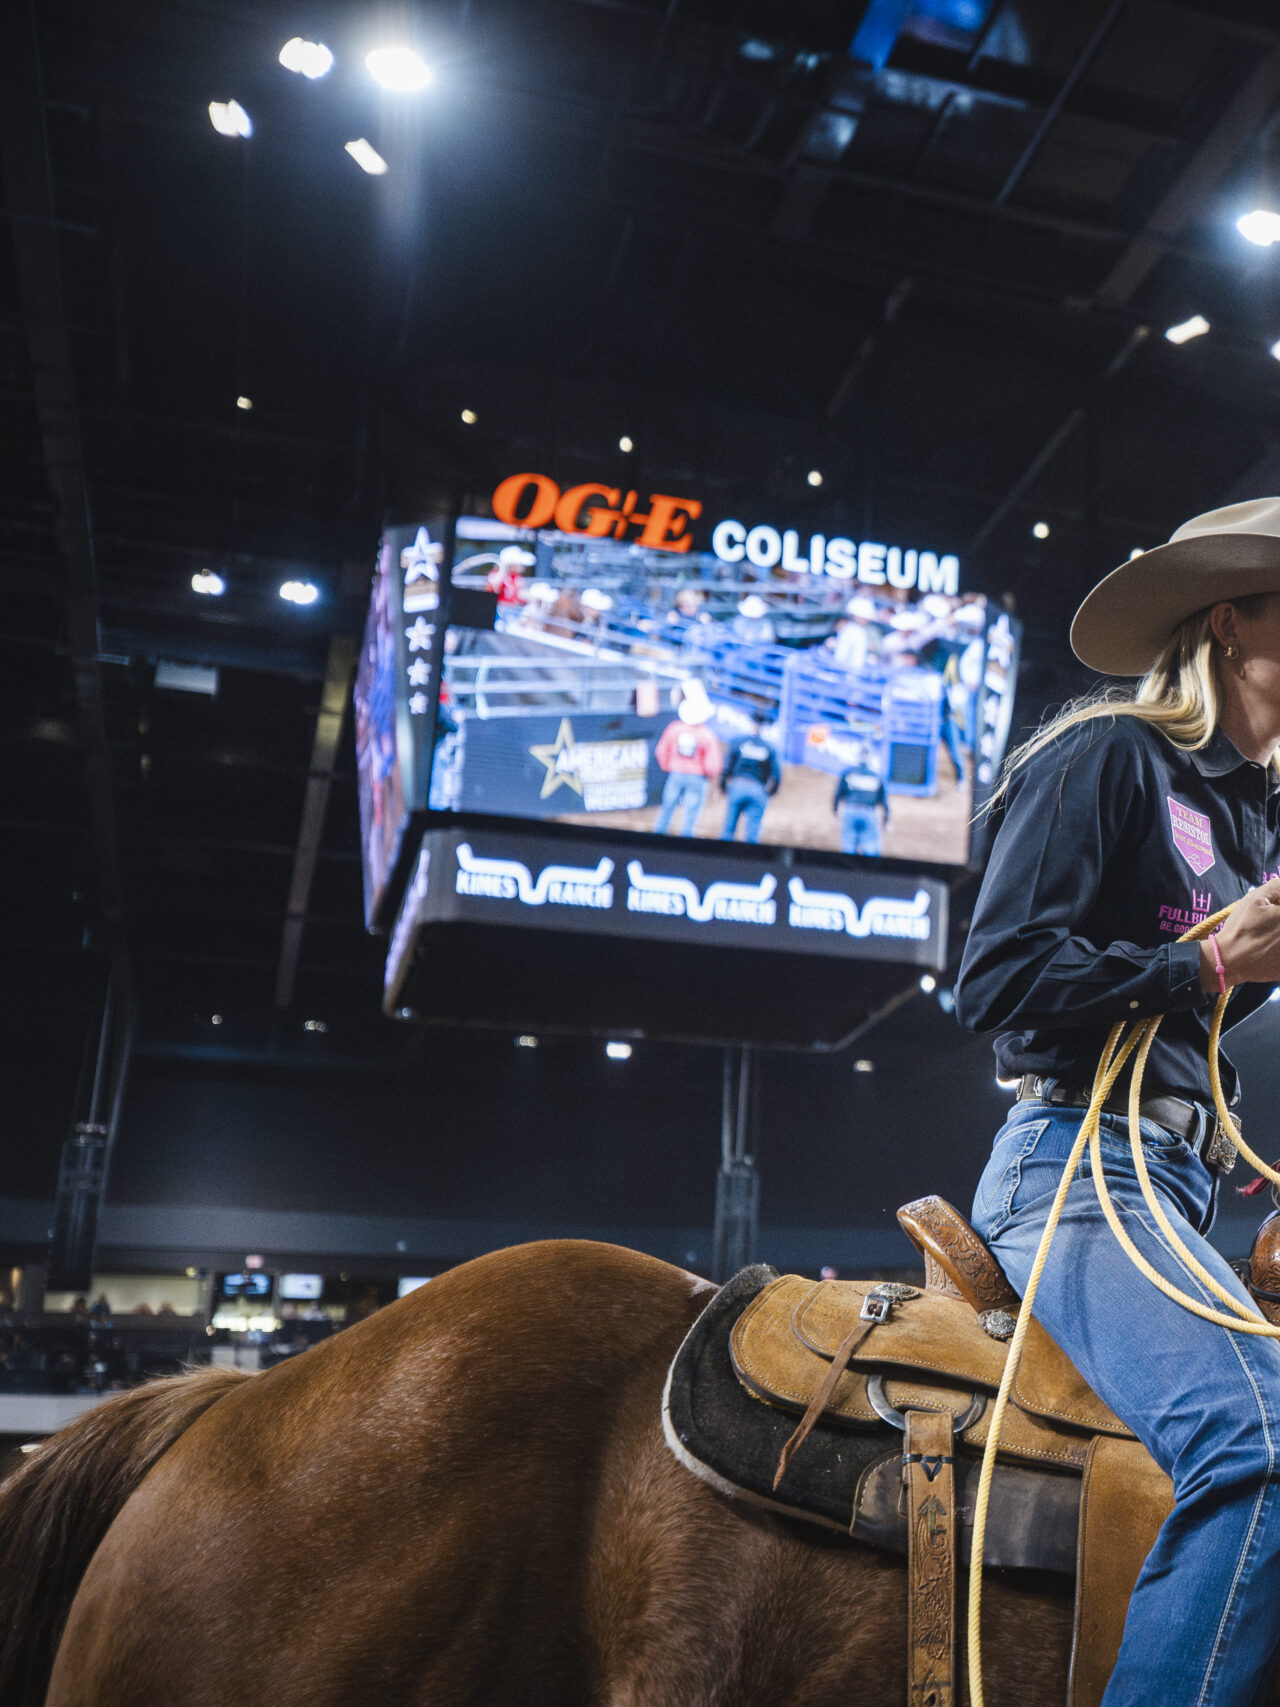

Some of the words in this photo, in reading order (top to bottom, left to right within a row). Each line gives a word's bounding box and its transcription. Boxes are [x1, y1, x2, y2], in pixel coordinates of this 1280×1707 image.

[712, 519, 961, 596] COLISEUM
[1172, 814, 1211, 846] RESISTOL
[1176, 806, 1204, 828] TEAM
